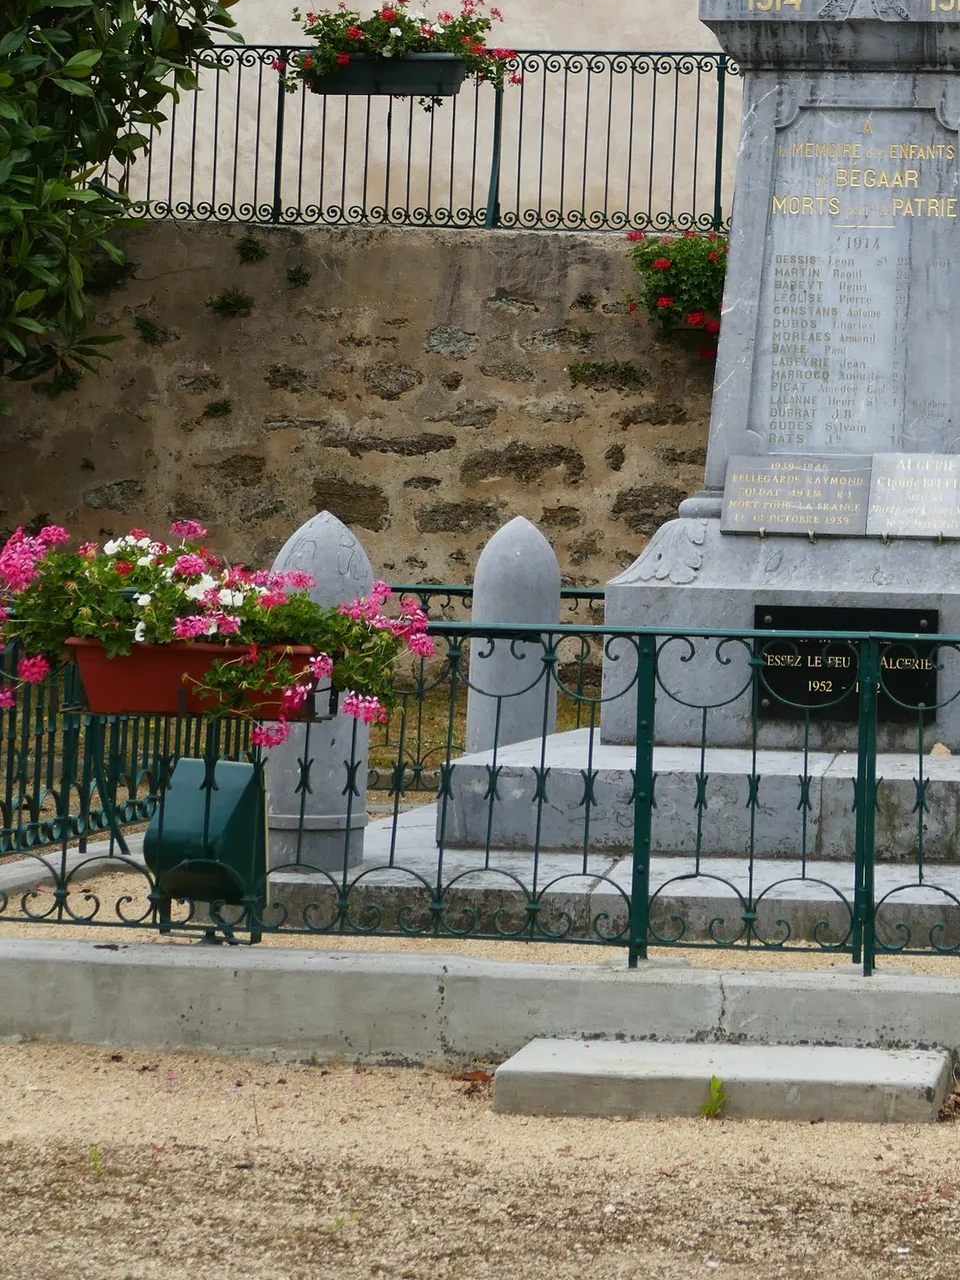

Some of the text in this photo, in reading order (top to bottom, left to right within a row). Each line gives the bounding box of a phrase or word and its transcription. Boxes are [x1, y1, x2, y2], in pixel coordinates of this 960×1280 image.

[889, 144, 955, 160] ENFANTS
[772, 196, 840, 215] MORTS
[846, 206, 870, 219] pour
[892, 198, 958, 217] PATRIE
[846, 236, 881, 251] 1914
[775, 254, 816, 265] DESSIS
[828, 255, 855, 267] Léon
[774, 267, 820, 277] MARTIN
[833, 269, 862, 279] Raoul
[839, 281, 867, 292] Henri
[839, 293, 872, 305] Pierre
[773, 306, 838, 317] CONSTANS
[846, 308, 881, 320] Antoine
[773, 319, 817, 329] DUBOS
[833, 320, 873, 331] Charles
[773, 332, 831, 342] MORLAES
[839, 332, 876, 344] Armand
[772, 344, 807, 354] BAYLE
[824, 345, 846, 356] Paul
[771, 357, 829, 368] LABEYRIE
[839, 359, 866, 370] Jean
[838, 371, 881, 383] Auguste
[771, 382, 807, 392] PICAT
[770, 394, 818, 405] LALANNE
[828, 396, 856, 407] Henri
[770, 408, 818, 418] DUPRAT
[824, 421, 867, 434] Sylvain
[768, 434, 805, 445] BATS
[731, 473, 864, 487] BELLEGARDE RAYMOND
[876, 476, 921, 489] Claude
[740, 487, 782, 498] SOLDAT
[728, 500, 760, 510] MORT
[763, 501, 793, 510] POUR
[817, 503, 861, 513] FRANCE
[769, 513, 820, 524] OCTOBRE
[825, 516, 850, 525] 1939
[807, 655, 822, 668] LE
[827, 656, 851, 670] FEU
[807, 680, 833, 693] 1952
[854, 681, 881, 694] 12
